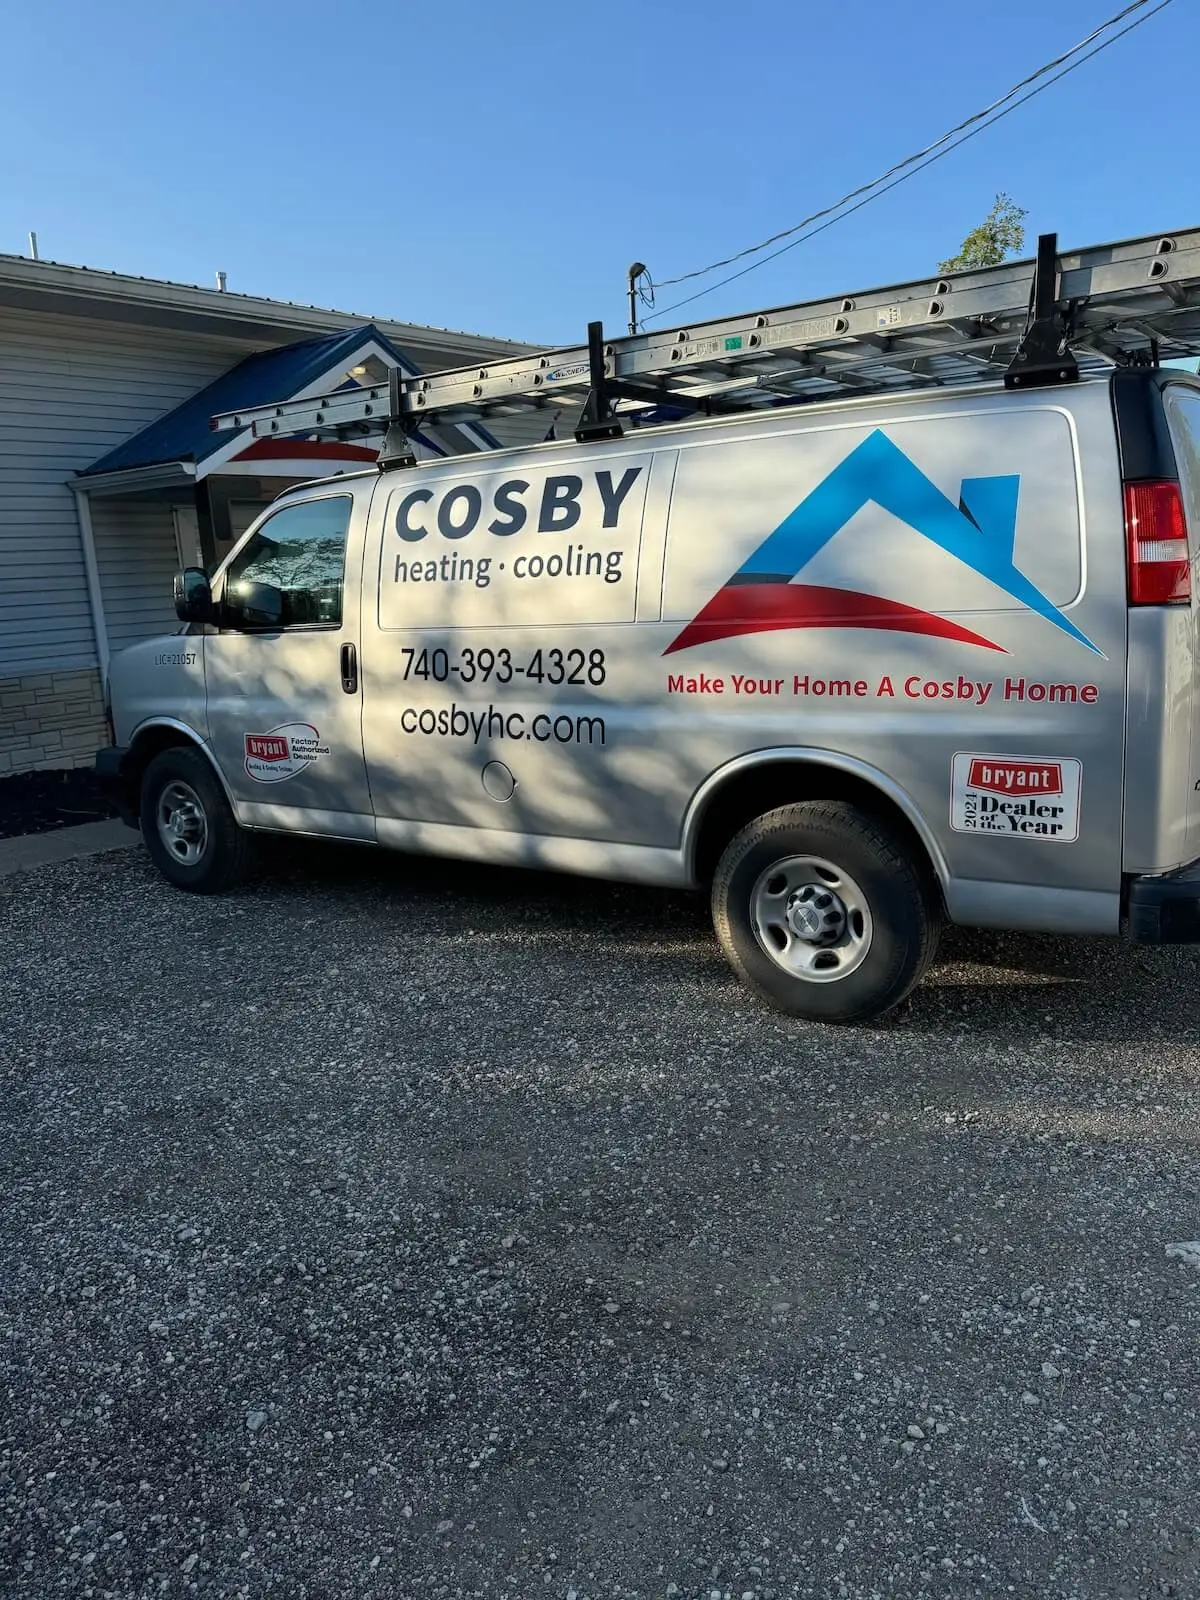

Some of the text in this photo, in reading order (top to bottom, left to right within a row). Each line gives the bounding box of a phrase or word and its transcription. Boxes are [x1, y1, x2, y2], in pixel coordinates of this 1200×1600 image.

[395, 466, 643, 542] COSBY
[394, 552, 492, 588] heating
[513, 544, 623, 583] cooling
[401, 648, 606, 686] 740-393-4328
[667, 674, 1099, 705] Make Your Home A Cosby Home
[400, 703, 606, 745] cosbyhc.com
[251, 739, 284, 756] bryant
[291, 738, 319, 747] Factory
[292, 745, 330, 754] Authorized
[293, 753, 318, 761] Dealer
[981, 765, 1050, 789] bryant
[964, 793, 978, 828] 2024
[980, 796, 1064, 818] Dealer
[980, 814, 999, 822] of
[980, 822, 1006, 831] the
[1007, 815, 1063, 835] Year
